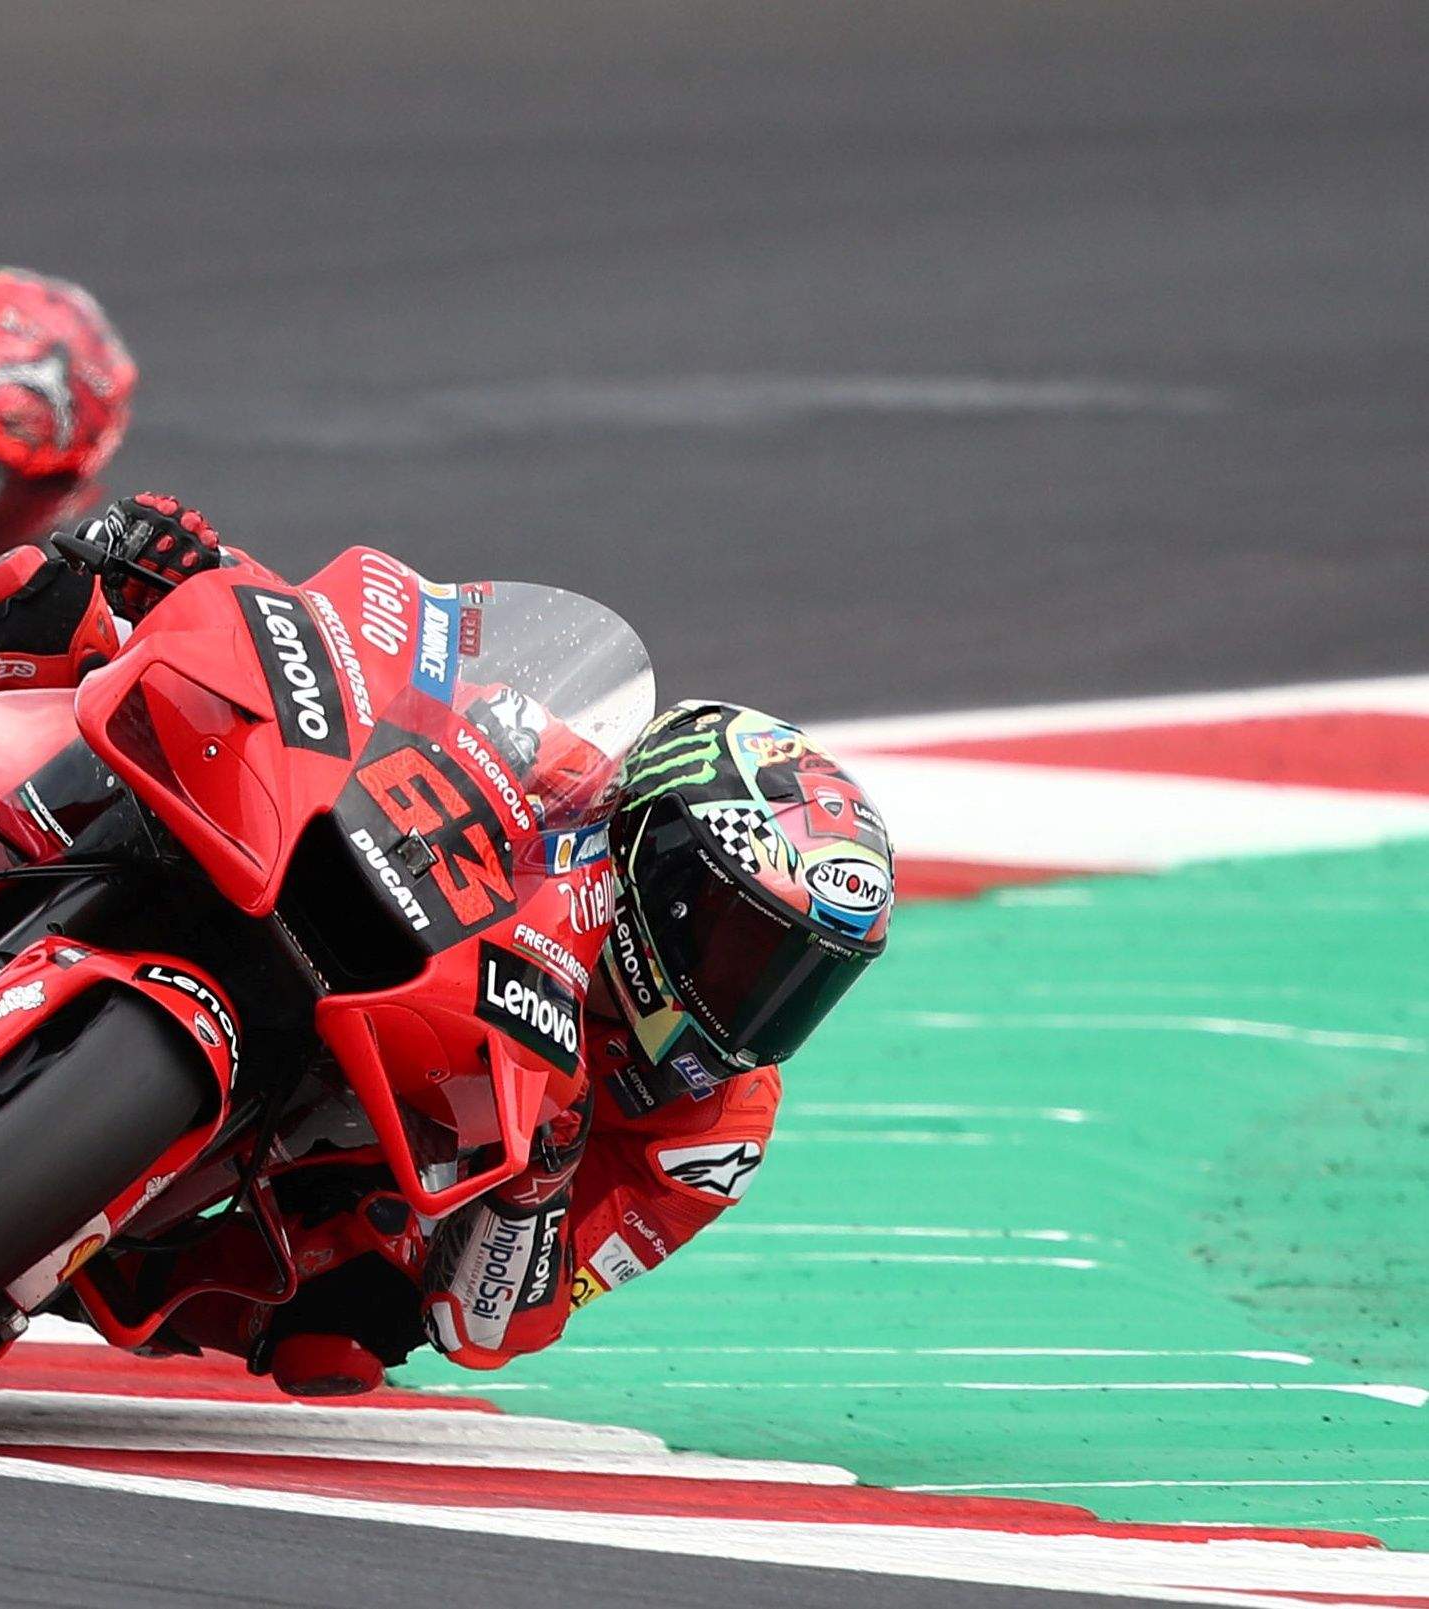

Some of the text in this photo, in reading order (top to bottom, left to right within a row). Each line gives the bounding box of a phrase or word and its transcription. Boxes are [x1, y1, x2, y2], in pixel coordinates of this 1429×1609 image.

[254, 593, 330, 741] Lenovo
[455, 729, 530, 832] VARGROUP
[350, 828, 430, 931] DUCATI
[356, 747, 517, 927] 63
[514, 923, 590, 992] FRECCIAROSS
[613, 905, 652, 1005] Lenovo
[486, 959, 577, 1053] Lenovo
[626, 1065, 655, 1107] Lenovo
[527, 1208, 566, 1304] Lenovo
[633, 1220, 658, 1240] Audi
